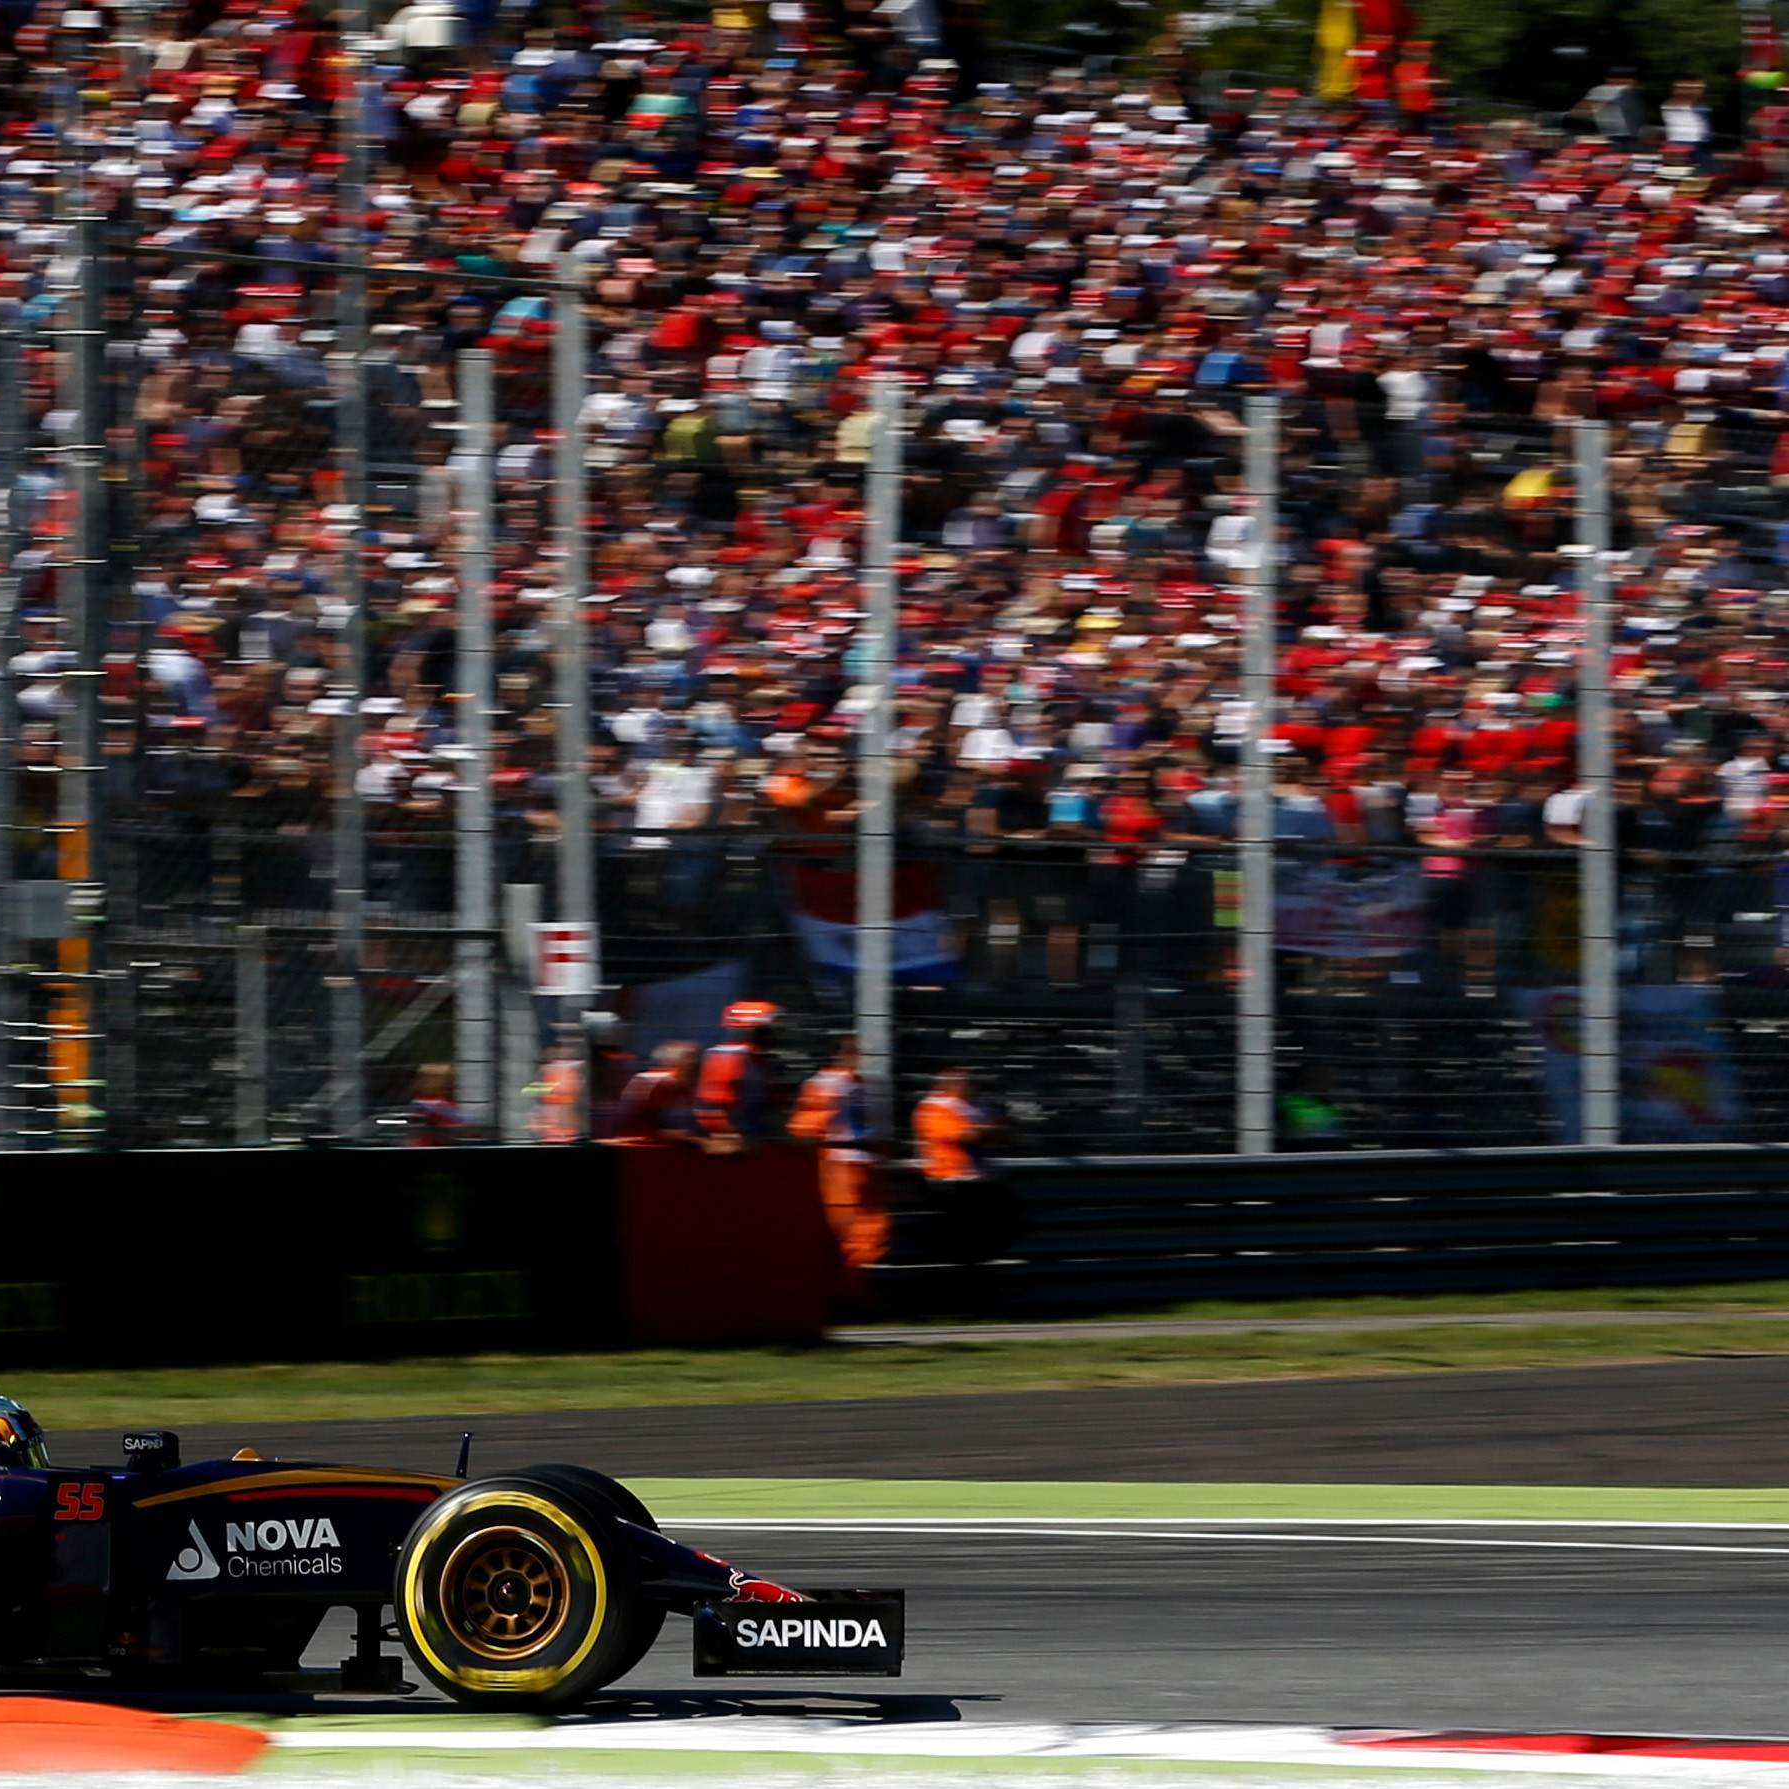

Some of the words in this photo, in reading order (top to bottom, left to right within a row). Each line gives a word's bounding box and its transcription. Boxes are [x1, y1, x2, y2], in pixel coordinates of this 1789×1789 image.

[55, 1483, 104, 1521] 55
[226, 1517, 341, 1552] NOVA
[227, 1552, 342, 1578] Chemicals
[736, 1618, 887, 1649] SAPINDA
